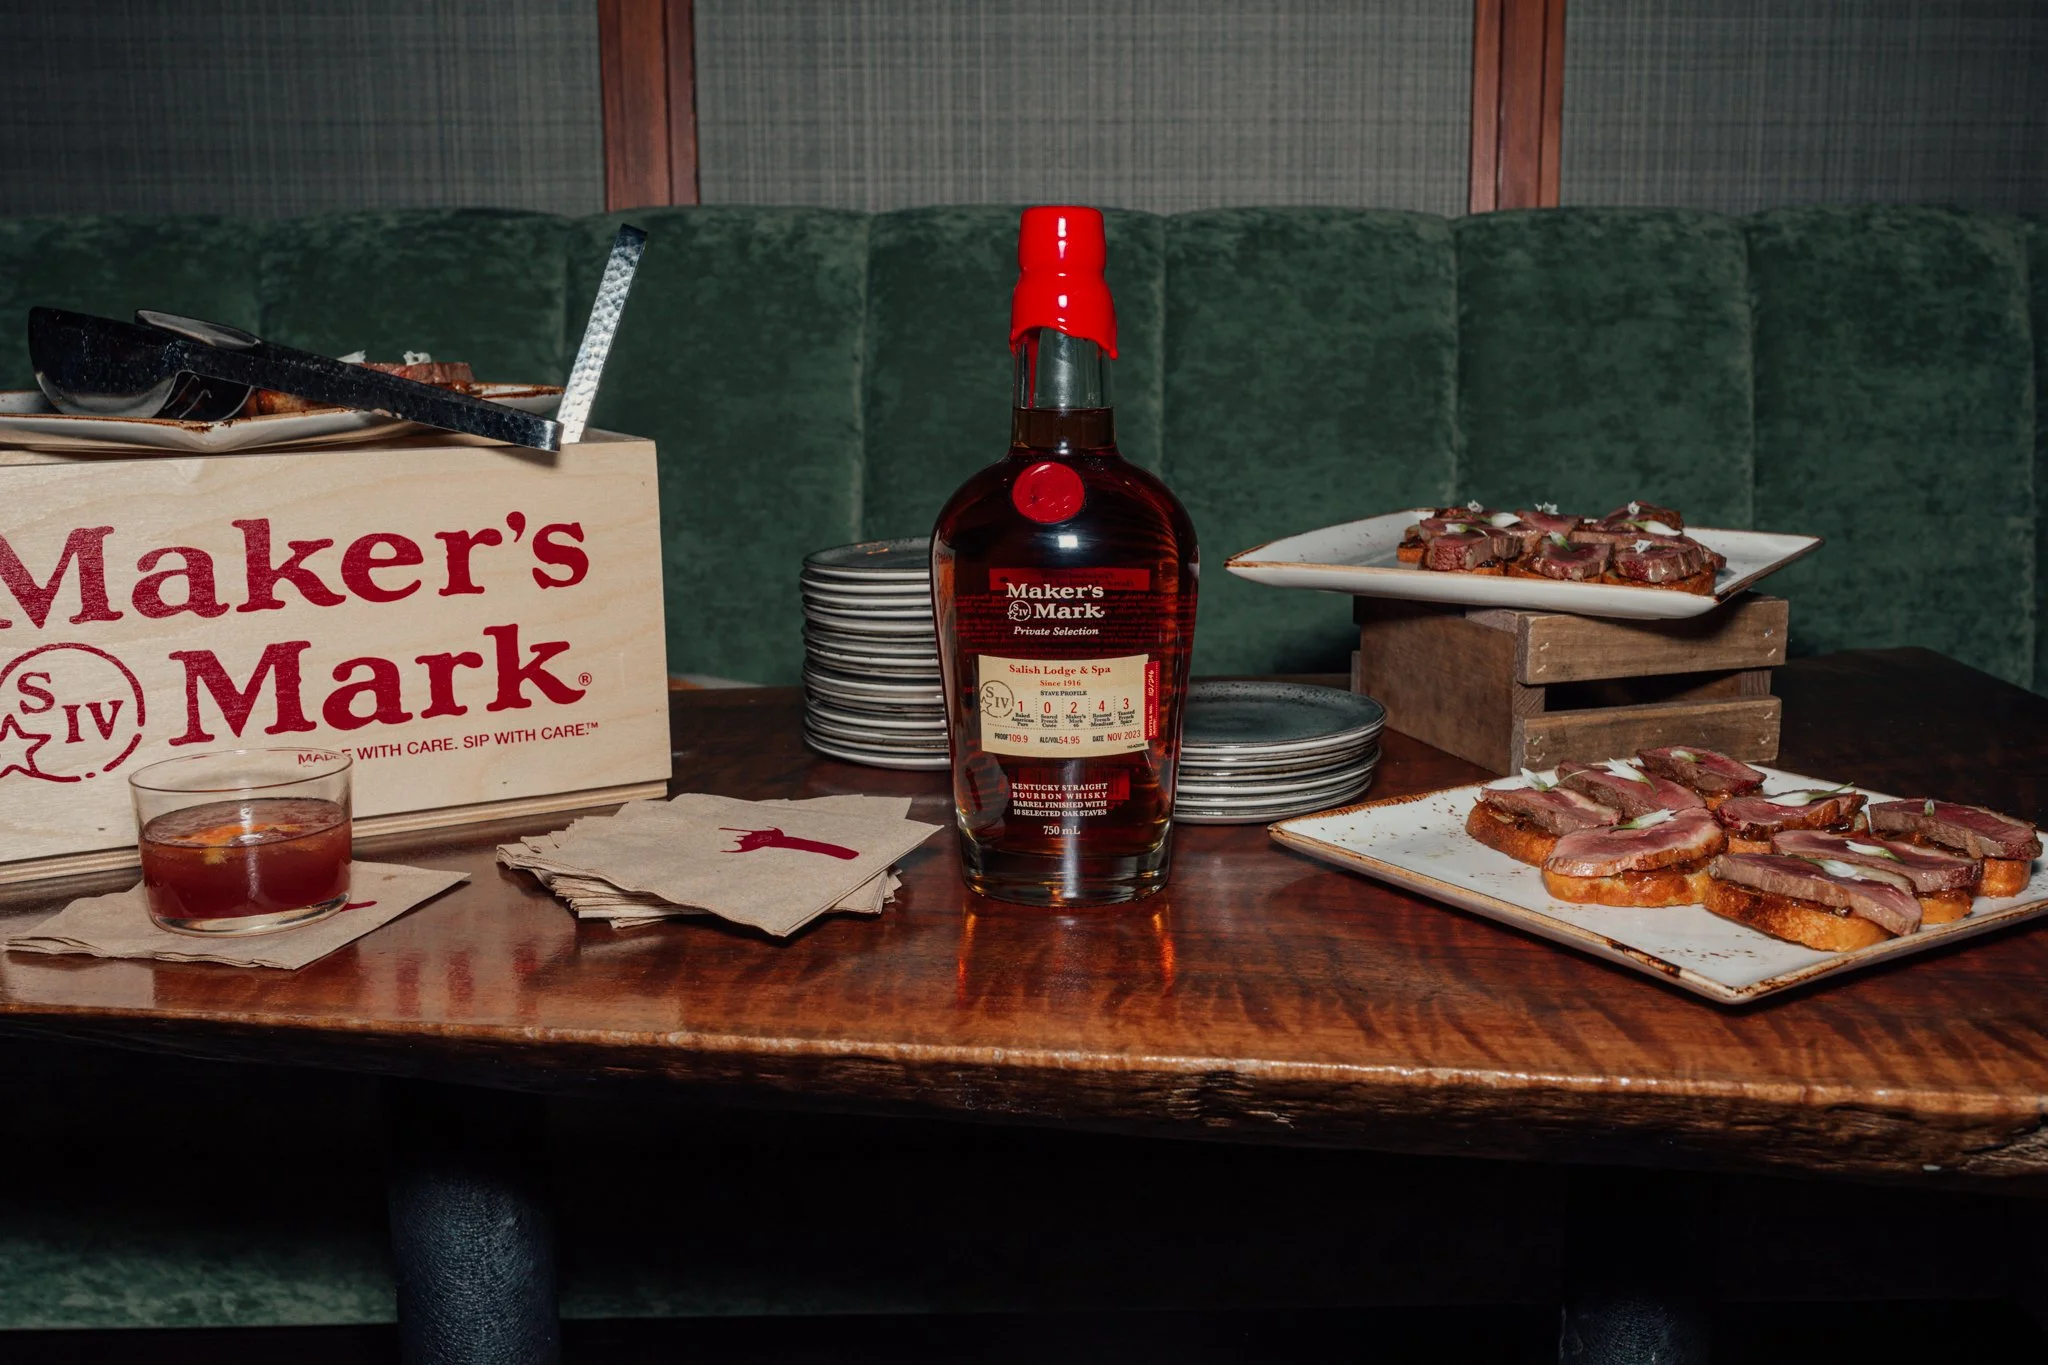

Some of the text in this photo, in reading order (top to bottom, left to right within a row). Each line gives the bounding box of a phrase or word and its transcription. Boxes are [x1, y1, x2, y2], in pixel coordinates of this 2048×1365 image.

[0, 511, 590, 630] Maker's
[1006, 582, 1104, 599] Maker's
[1034, 603, 1106, 619] Mark
[1013, 626, 1099, 636] Private Selection
[1009, 664, 1111, 677] Salish Lodge & Spa
[17, 671, 124, 744] S IV
[1018, 698, 1130, 713] 1 0 2 4 3
[357, 743, 402, 760] WITH
[407, 737, 459, 755] CARE.
[463, 734, 490, 749] SIP
[494, 729, 536, 745] WITH
[994, 732, 1009, 740] PROOF
[1009, 733, 1028, 743] 109.9
[1059, 736, 1080, 745] 54.95
[1107, 733, 1122, 742] NOV
[1124, 730, 1141, 739] 2023
[1012, 782, 1108, 792] KENTUCKY STRAIGHT
[1013, 791, 1108, 799] BOURBON WHISKY
[1013, 800, 1044, 808] BARREL
[1085, 800, 1107, 808] WITH
[1014, 808, 1107, 817] 10 SELECTED OAK STAVES
[1043, 826, 1080, 835] 750 mL
